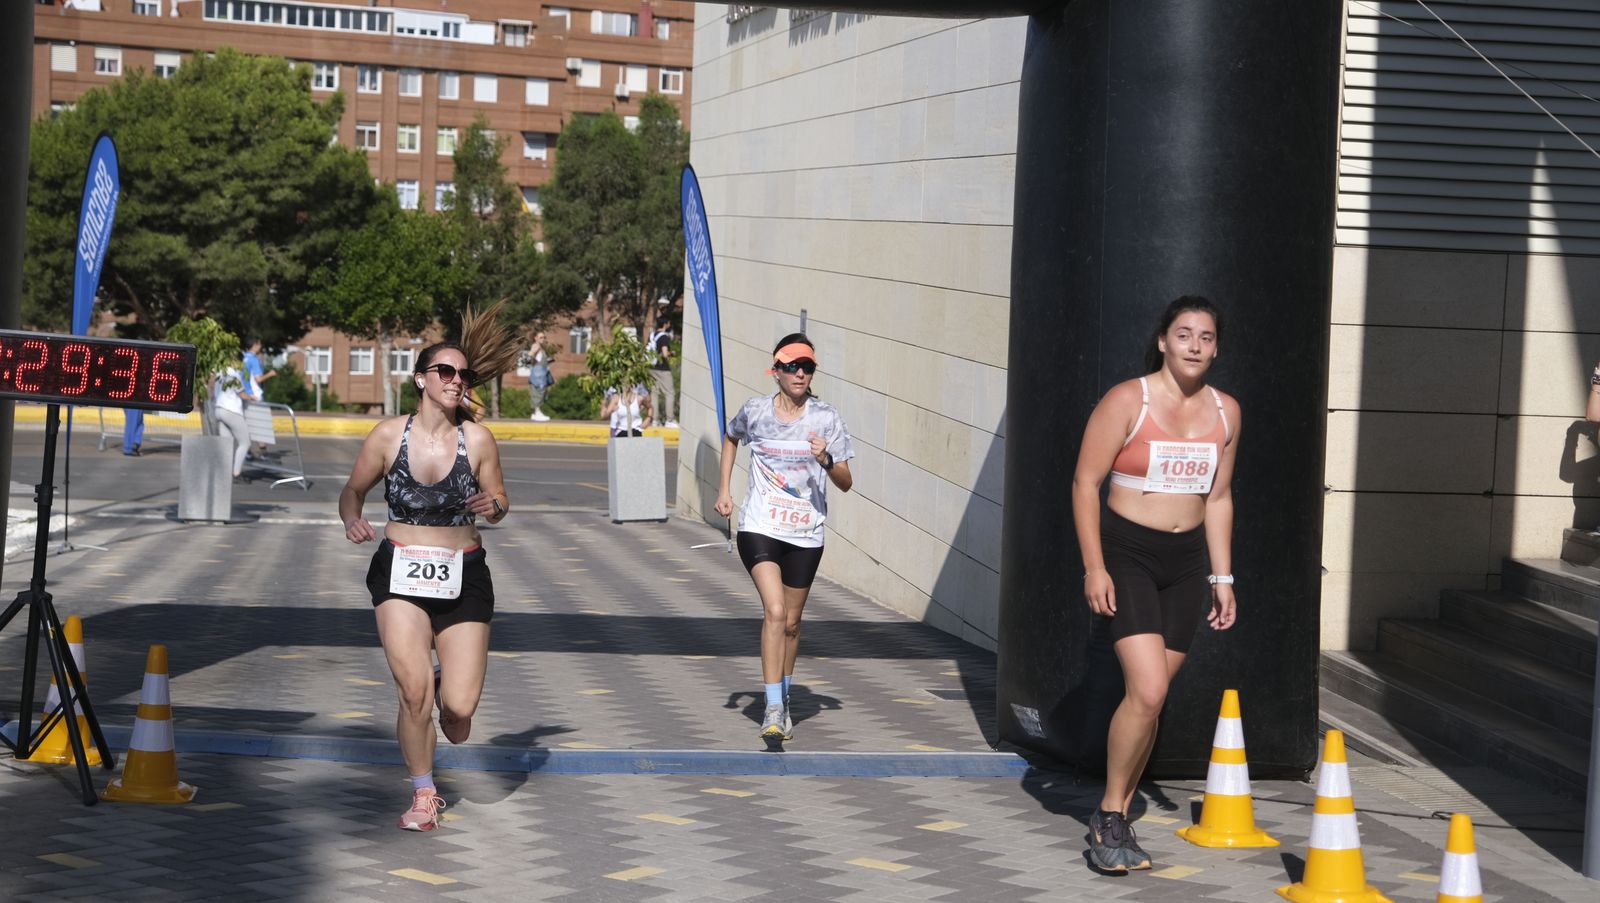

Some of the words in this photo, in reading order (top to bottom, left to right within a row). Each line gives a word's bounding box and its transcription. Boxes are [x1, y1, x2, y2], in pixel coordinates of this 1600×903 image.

[0, 339, 180, 402] :29:36
[1160, 459, 1209, 476] 1088
[769, 507, 811, 525] 1164
[406, 562, 450, 582] 203
